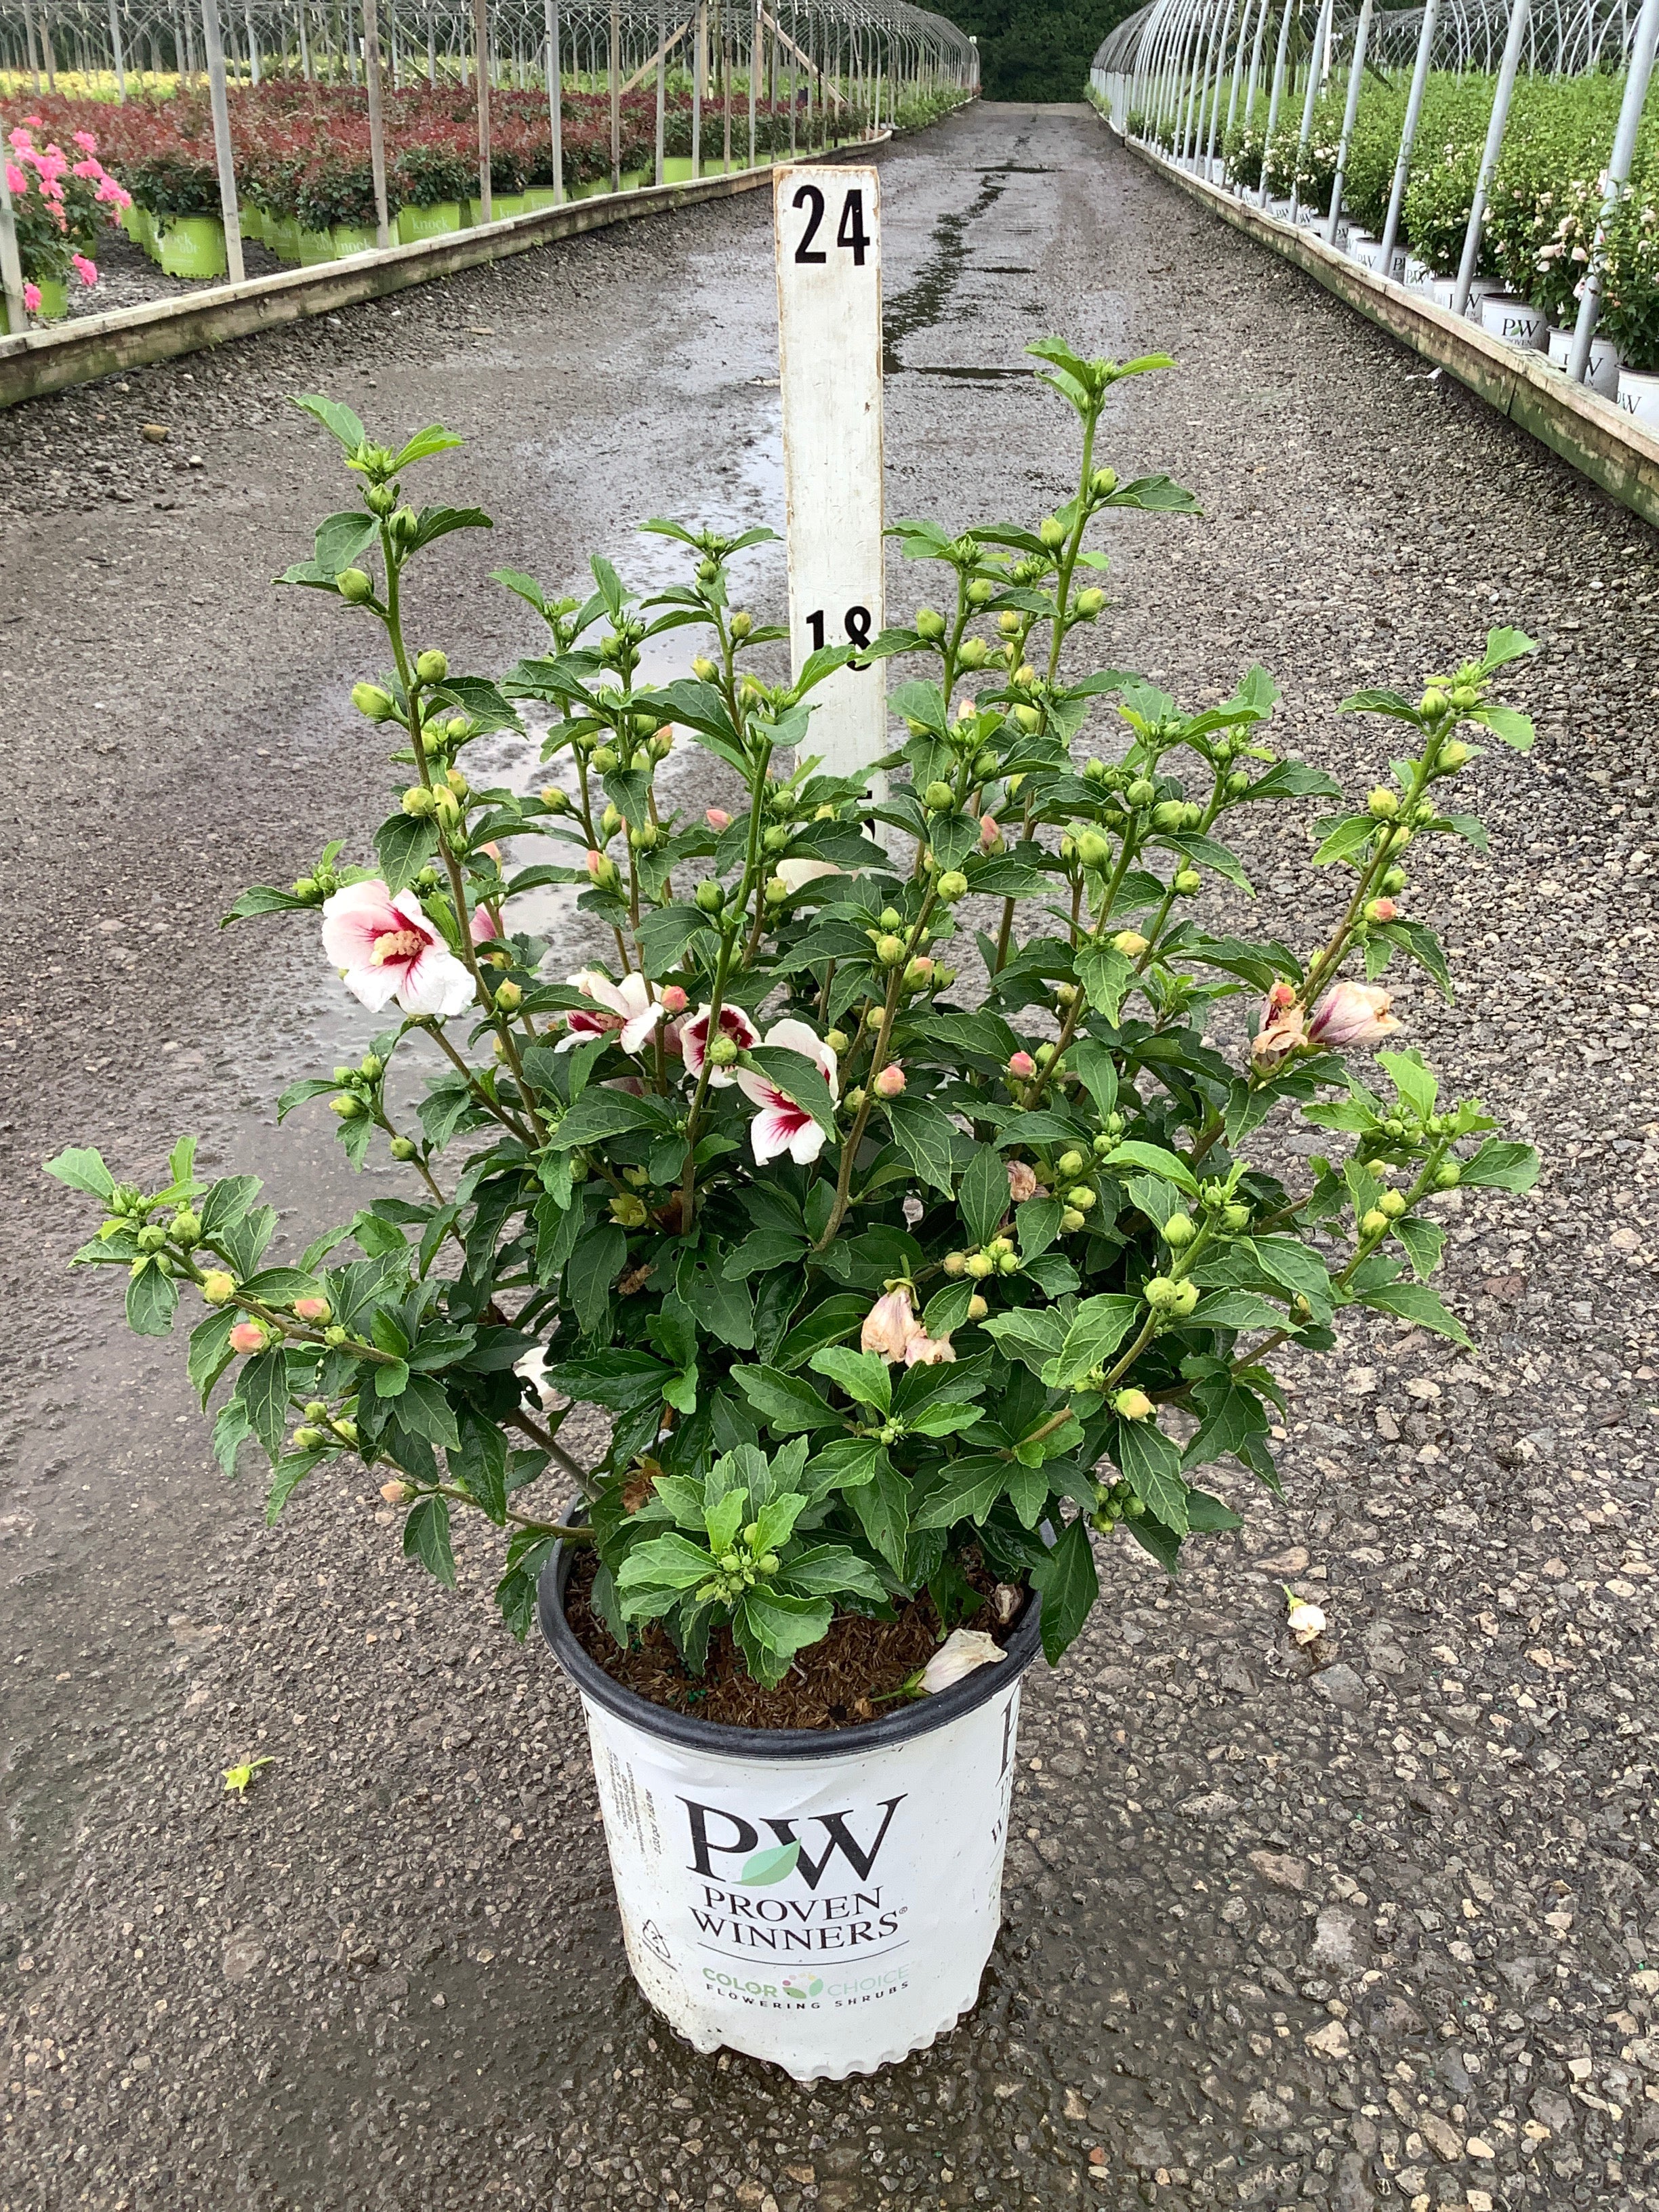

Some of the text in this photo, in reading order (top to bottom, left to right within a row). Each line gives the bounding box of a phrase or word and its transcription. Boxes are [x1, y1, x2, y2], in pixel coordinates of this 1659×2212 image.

[792, 184, 870, 266] 24
[1502, 318, 1541, 337] PW
[806, 606, 872, 672] 18
[674, 1793, 909, 1890] PW
[701, 1884, 884, 1922] PROVEN
[702, 1964, 910, 1998] COLOR CHOICE
[705, 1981, 909, 2009] FLOWERING SHRUBS
